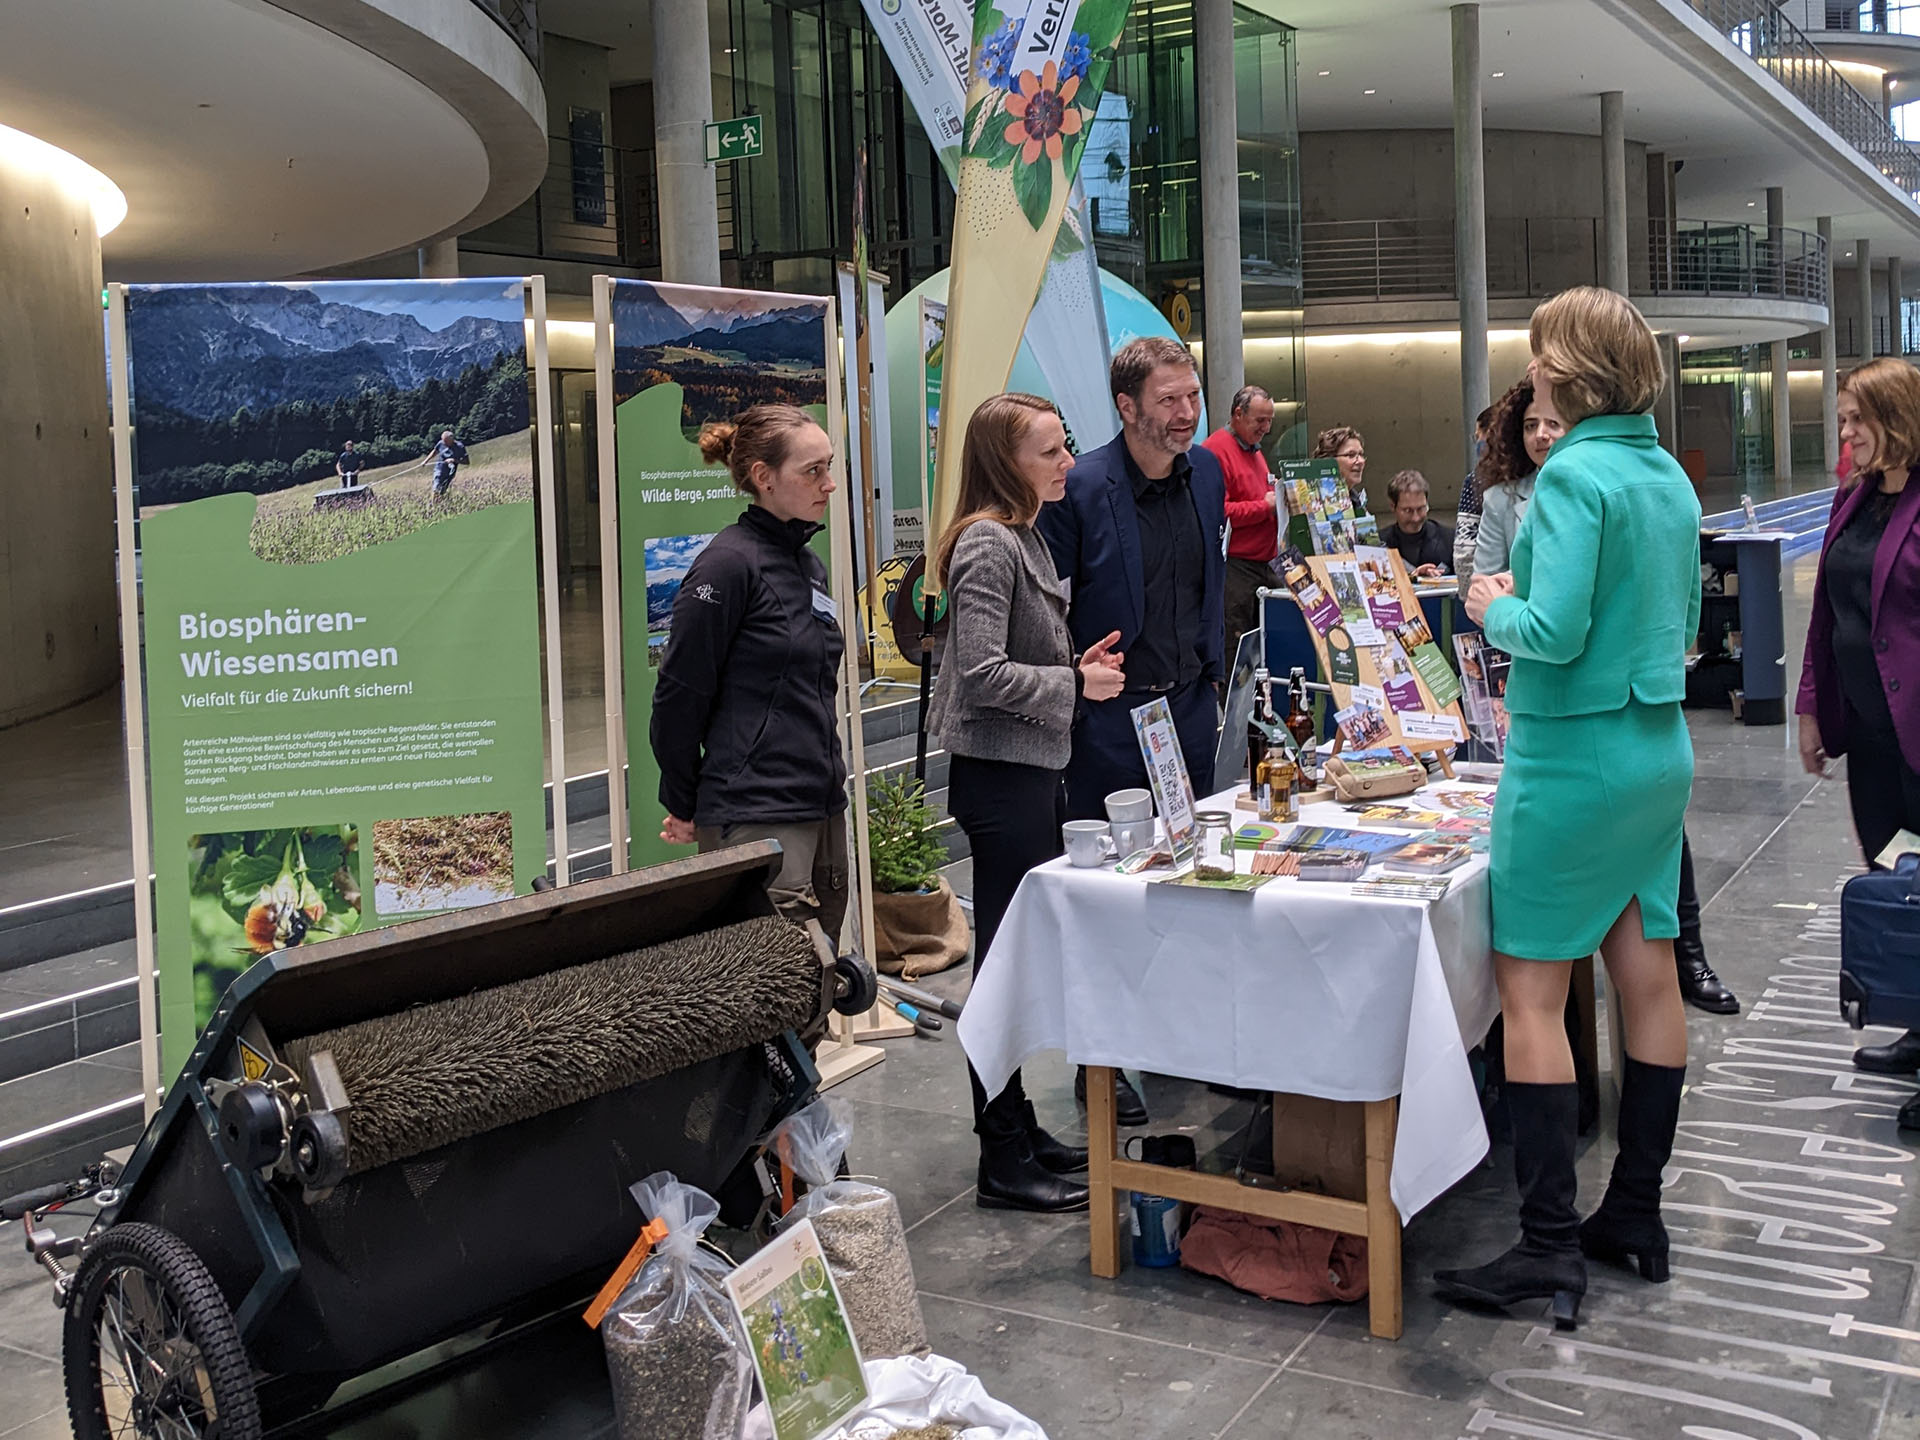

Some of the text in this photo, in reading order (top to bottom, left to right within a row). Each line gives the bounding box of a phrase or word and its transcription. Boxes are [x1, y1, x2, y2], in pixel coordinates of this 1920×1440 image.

[1028, 0, 1068, 54] Ver
[640, 469, 692, 481] Biosphärenregion
[641, 487, 673, 503] Wilde
[674, 486, 705, 504] Berge,
[706, 484, 737, 500] sanfte
[179, 608, 367, 644] Biosphären-
[180, 646, 398, 678] Wiesensamen
[181, 681, 414, 708] Vielfalt für die Zukunft sichern!
[183, 737, 229, 747] Artenreiche
[274, 733, 291, 741] sind
[292, 733, 301, 741] so
[303, 730, 336, 740] vielfältig
[337, 729, 351, 737] wie
[352, 726, 387, 737] tropische
[388, 723, 440, 734] Regenwälder.
[441, 722, 452, 730] Sie
[453, 719, 497, 729] entstanden
[183, 748, 206, 757] durch
[226, 745, 263, 754] extensive
[264, 740, 327, 751] Bewirtschaftung
[328, 738, 342, 747] des
[343, 737, 383, 746] Menschen
[383, 735, 398, 743] und
[399, 733, 416, 742] sind
[416, 732, 440, 741] heute
[441, 732, 454, 740] von
[455, 729, 480, 738] einem
[184, 738, 494, 766] starken Rückgang bedroht. Daher haben wir es uns zum Ziel gesetzt, die wertvollen
[184, 767, 212, 776] Samen
[213, 766, 228, 774] von
[228, 764, 250, 774] Berg-
[251, 763, 267, 772] und
[350, 756, 360, 765] zu
[360, 755, 387, 764] ernten
[387, 753, 403, 762] und
[403, 752, 423, 761] neue
[424, 750, 454, 760] Flächen
[454, 748, 478, 758] damit
[184, 776, 228, 786] anzulegen.
[185, 775, 494, 805] Mit diesem Projekt sichern wir Arten, Lebensräume und eine genetische Vielfalt für
[185, 801, 275, 815] künftige Generationen!
